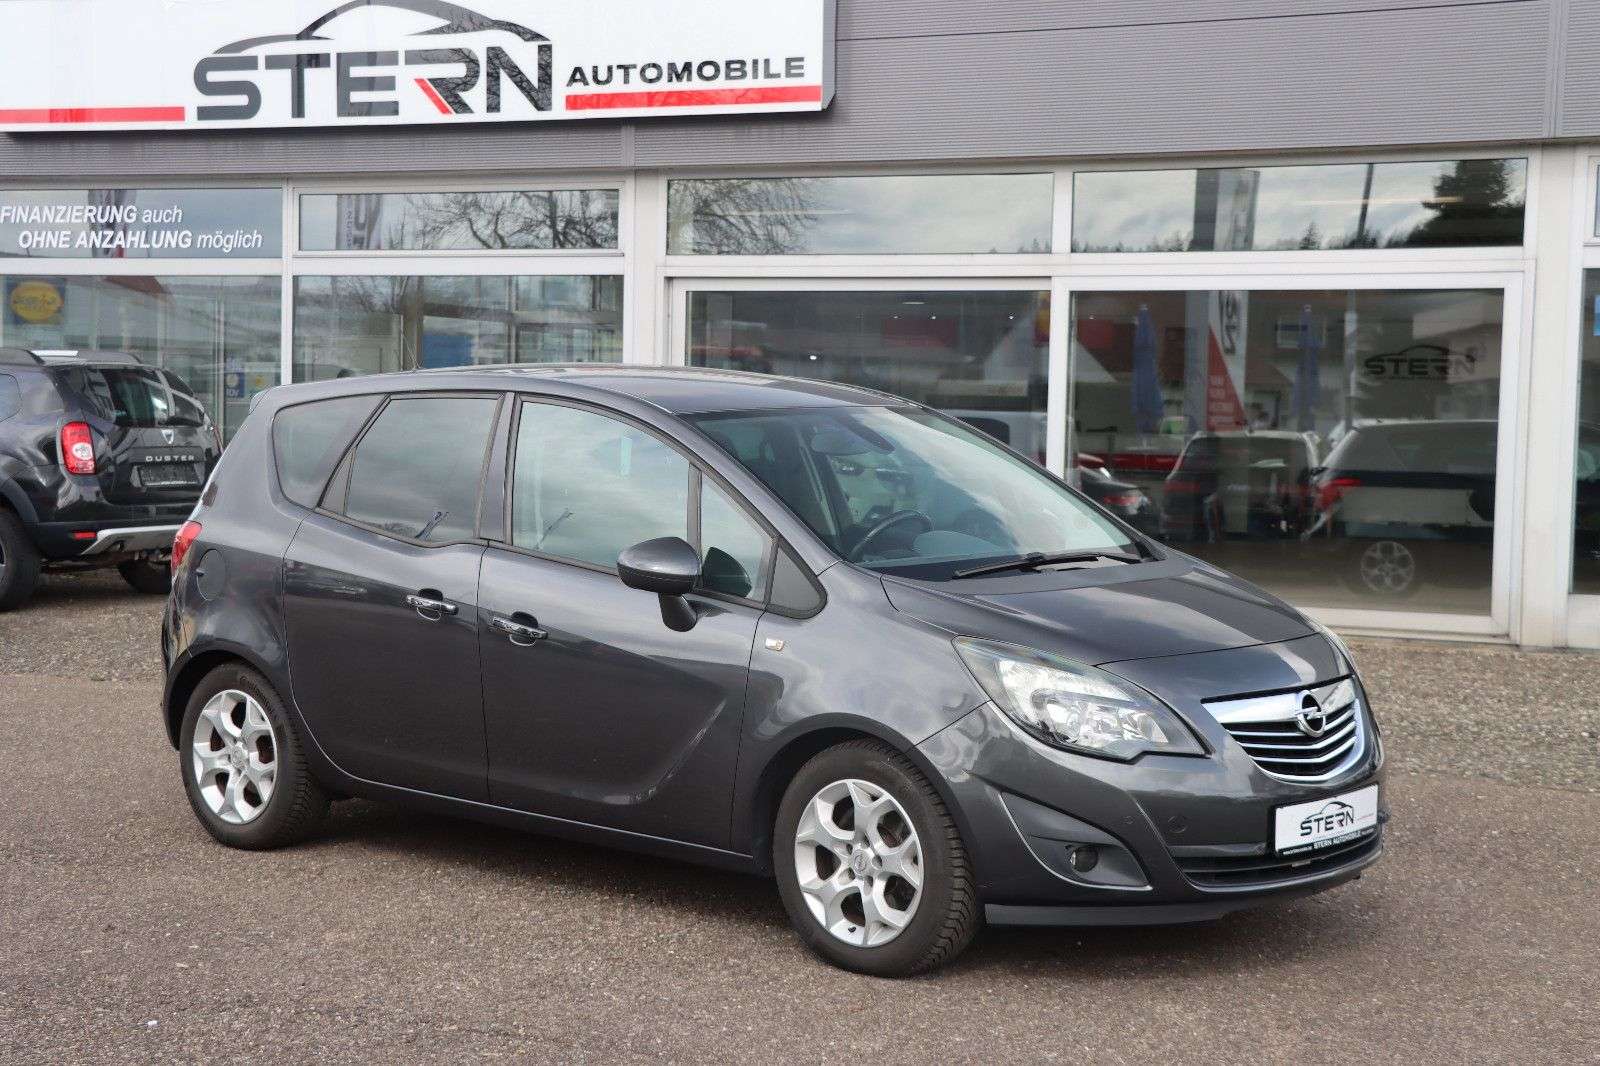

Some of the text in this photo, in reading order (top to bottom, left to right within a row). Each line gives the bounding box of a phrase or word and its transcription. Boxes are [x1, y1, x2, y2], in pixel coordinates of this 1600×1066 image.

[195, 44, 806, 120] STERN AUTOMOBILE
[1, 205, 183, 224] FINANZIERUNG auch
[19, 230, 263, 254] OHNE ANZAHLUNG möglich
[1364, 358, 1475, 376] STERN
[1300, 811, 1354, 836] STERN
